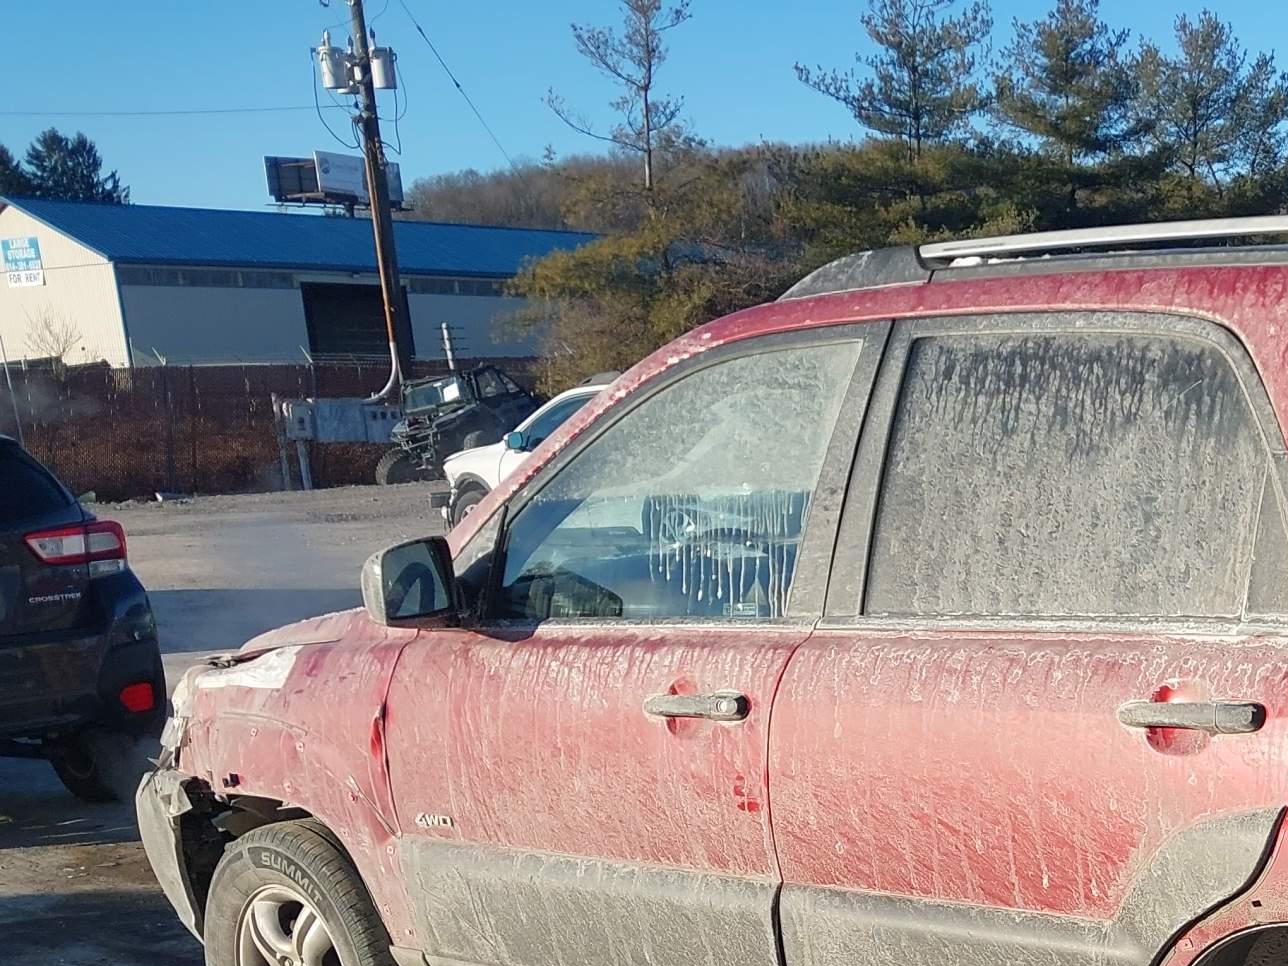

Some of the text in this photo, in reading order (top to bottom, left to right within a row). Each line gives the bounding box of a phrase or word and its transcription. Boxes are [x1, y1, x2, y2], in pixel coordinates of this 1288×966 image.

[9, 271, 40, 284] FOR RENT
[28, 591, 82, 604] CROSSTREK
[414, 811, 455, 829] 4WD
[261, 851, 323, 903] SUMMIT
